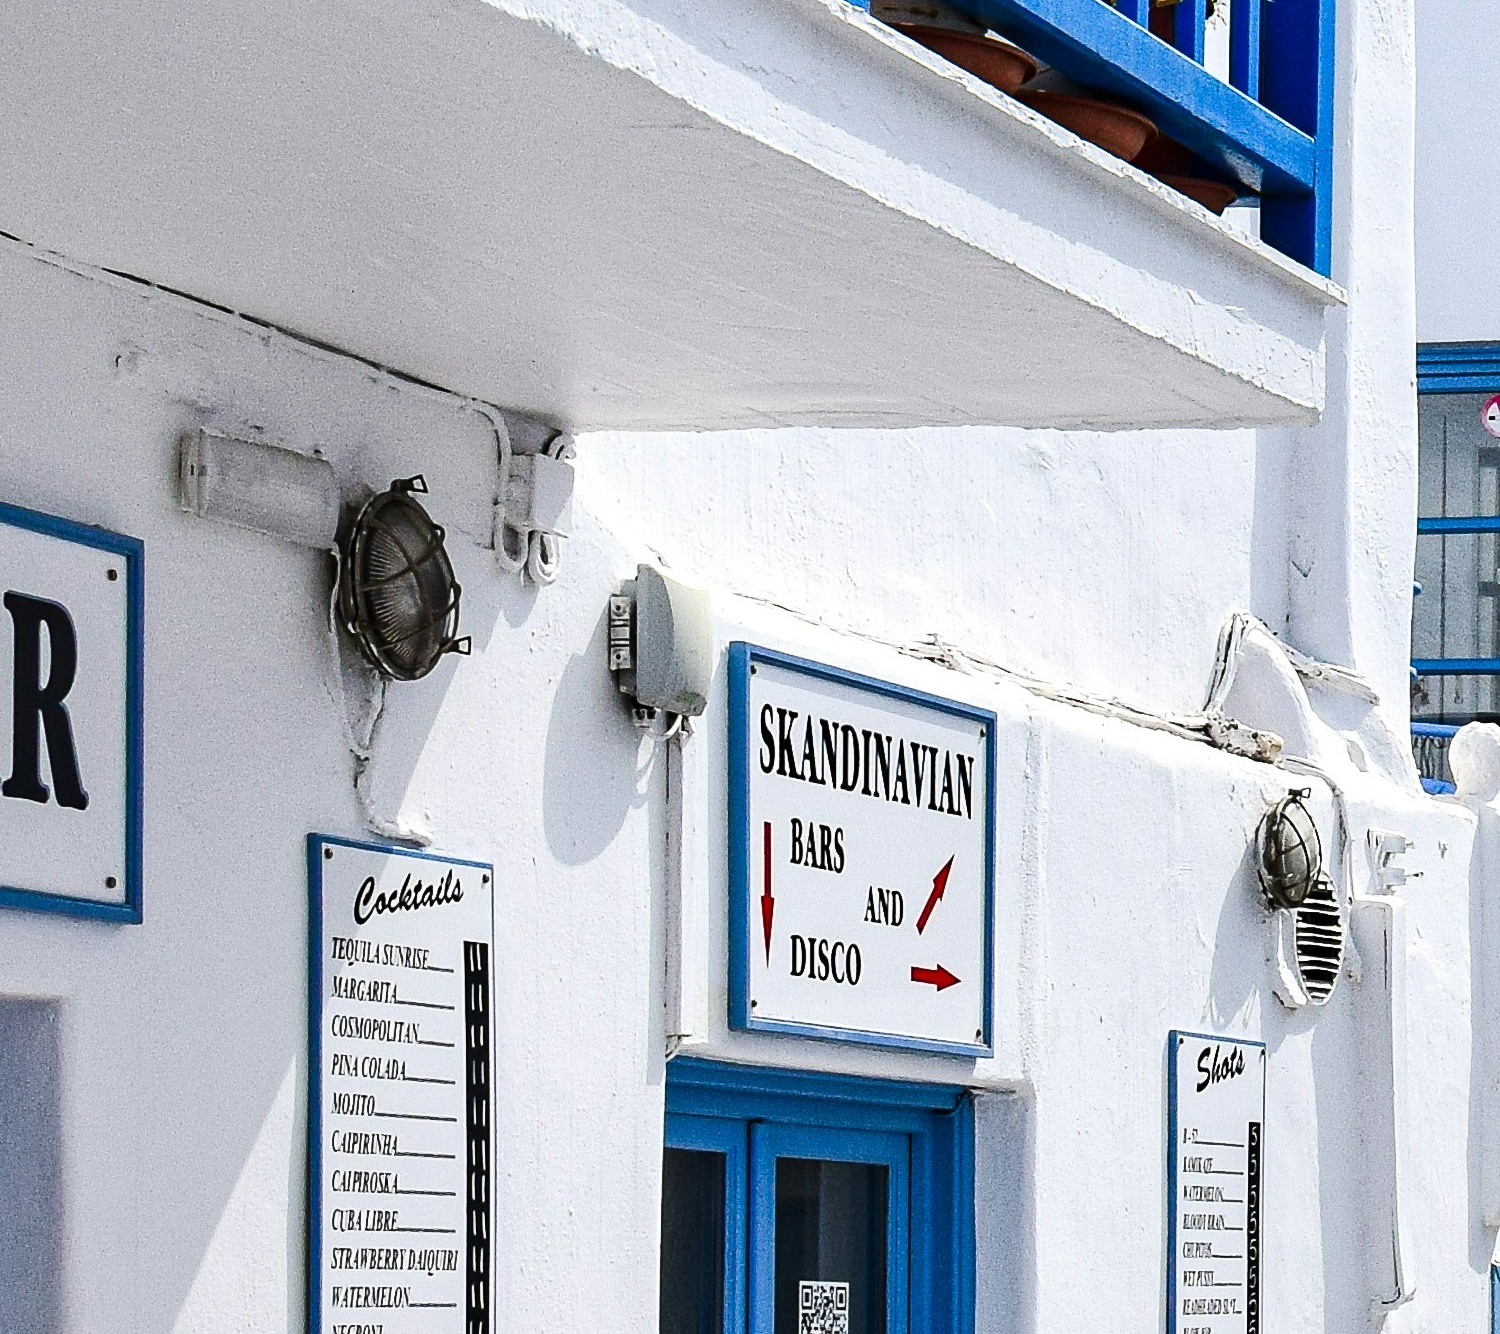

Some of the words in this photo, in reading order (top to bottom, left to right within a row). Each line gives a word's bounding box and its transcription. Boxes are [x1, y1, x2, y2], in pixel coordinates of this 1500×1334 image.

[759, 703, 975, 820] SKANDINAVIAN
[790, 817, 845, 874] BARS
[354, 869, 464, 925] Cocktails
[864, 885, 904, 928] AND
[331, 937, 380, 966] TEQUILA
[382, 944, 430, 970] SUNRISE
[790, 934, 862, 986] DISCO
[331, 976, 398, 1004] MARGARITA
[331, 1014, 420, 1044] COSMOPOLITAN
[331, 1054, 358, 1077] PINA
[361, 1056, 406, 1081] COLADA
[1196, 1045, 1245, 1092] Shots
[331, 1092, 376, 1116] MOJITO
[331, 1130, 398, 1156] CAIPIRINHA
[331, 1169, 398, 1194] CAIPIROSKA
[331, 1209, 362, 1232] CUBA
[364, 1210, 399, 1231] LIBRE
[331, 1247, 405, 1270] STRAWBERRY
[408, 1248, 459, 1276] DAIQUIRI
[331, 1286, 411, 1308] WATERMELON
